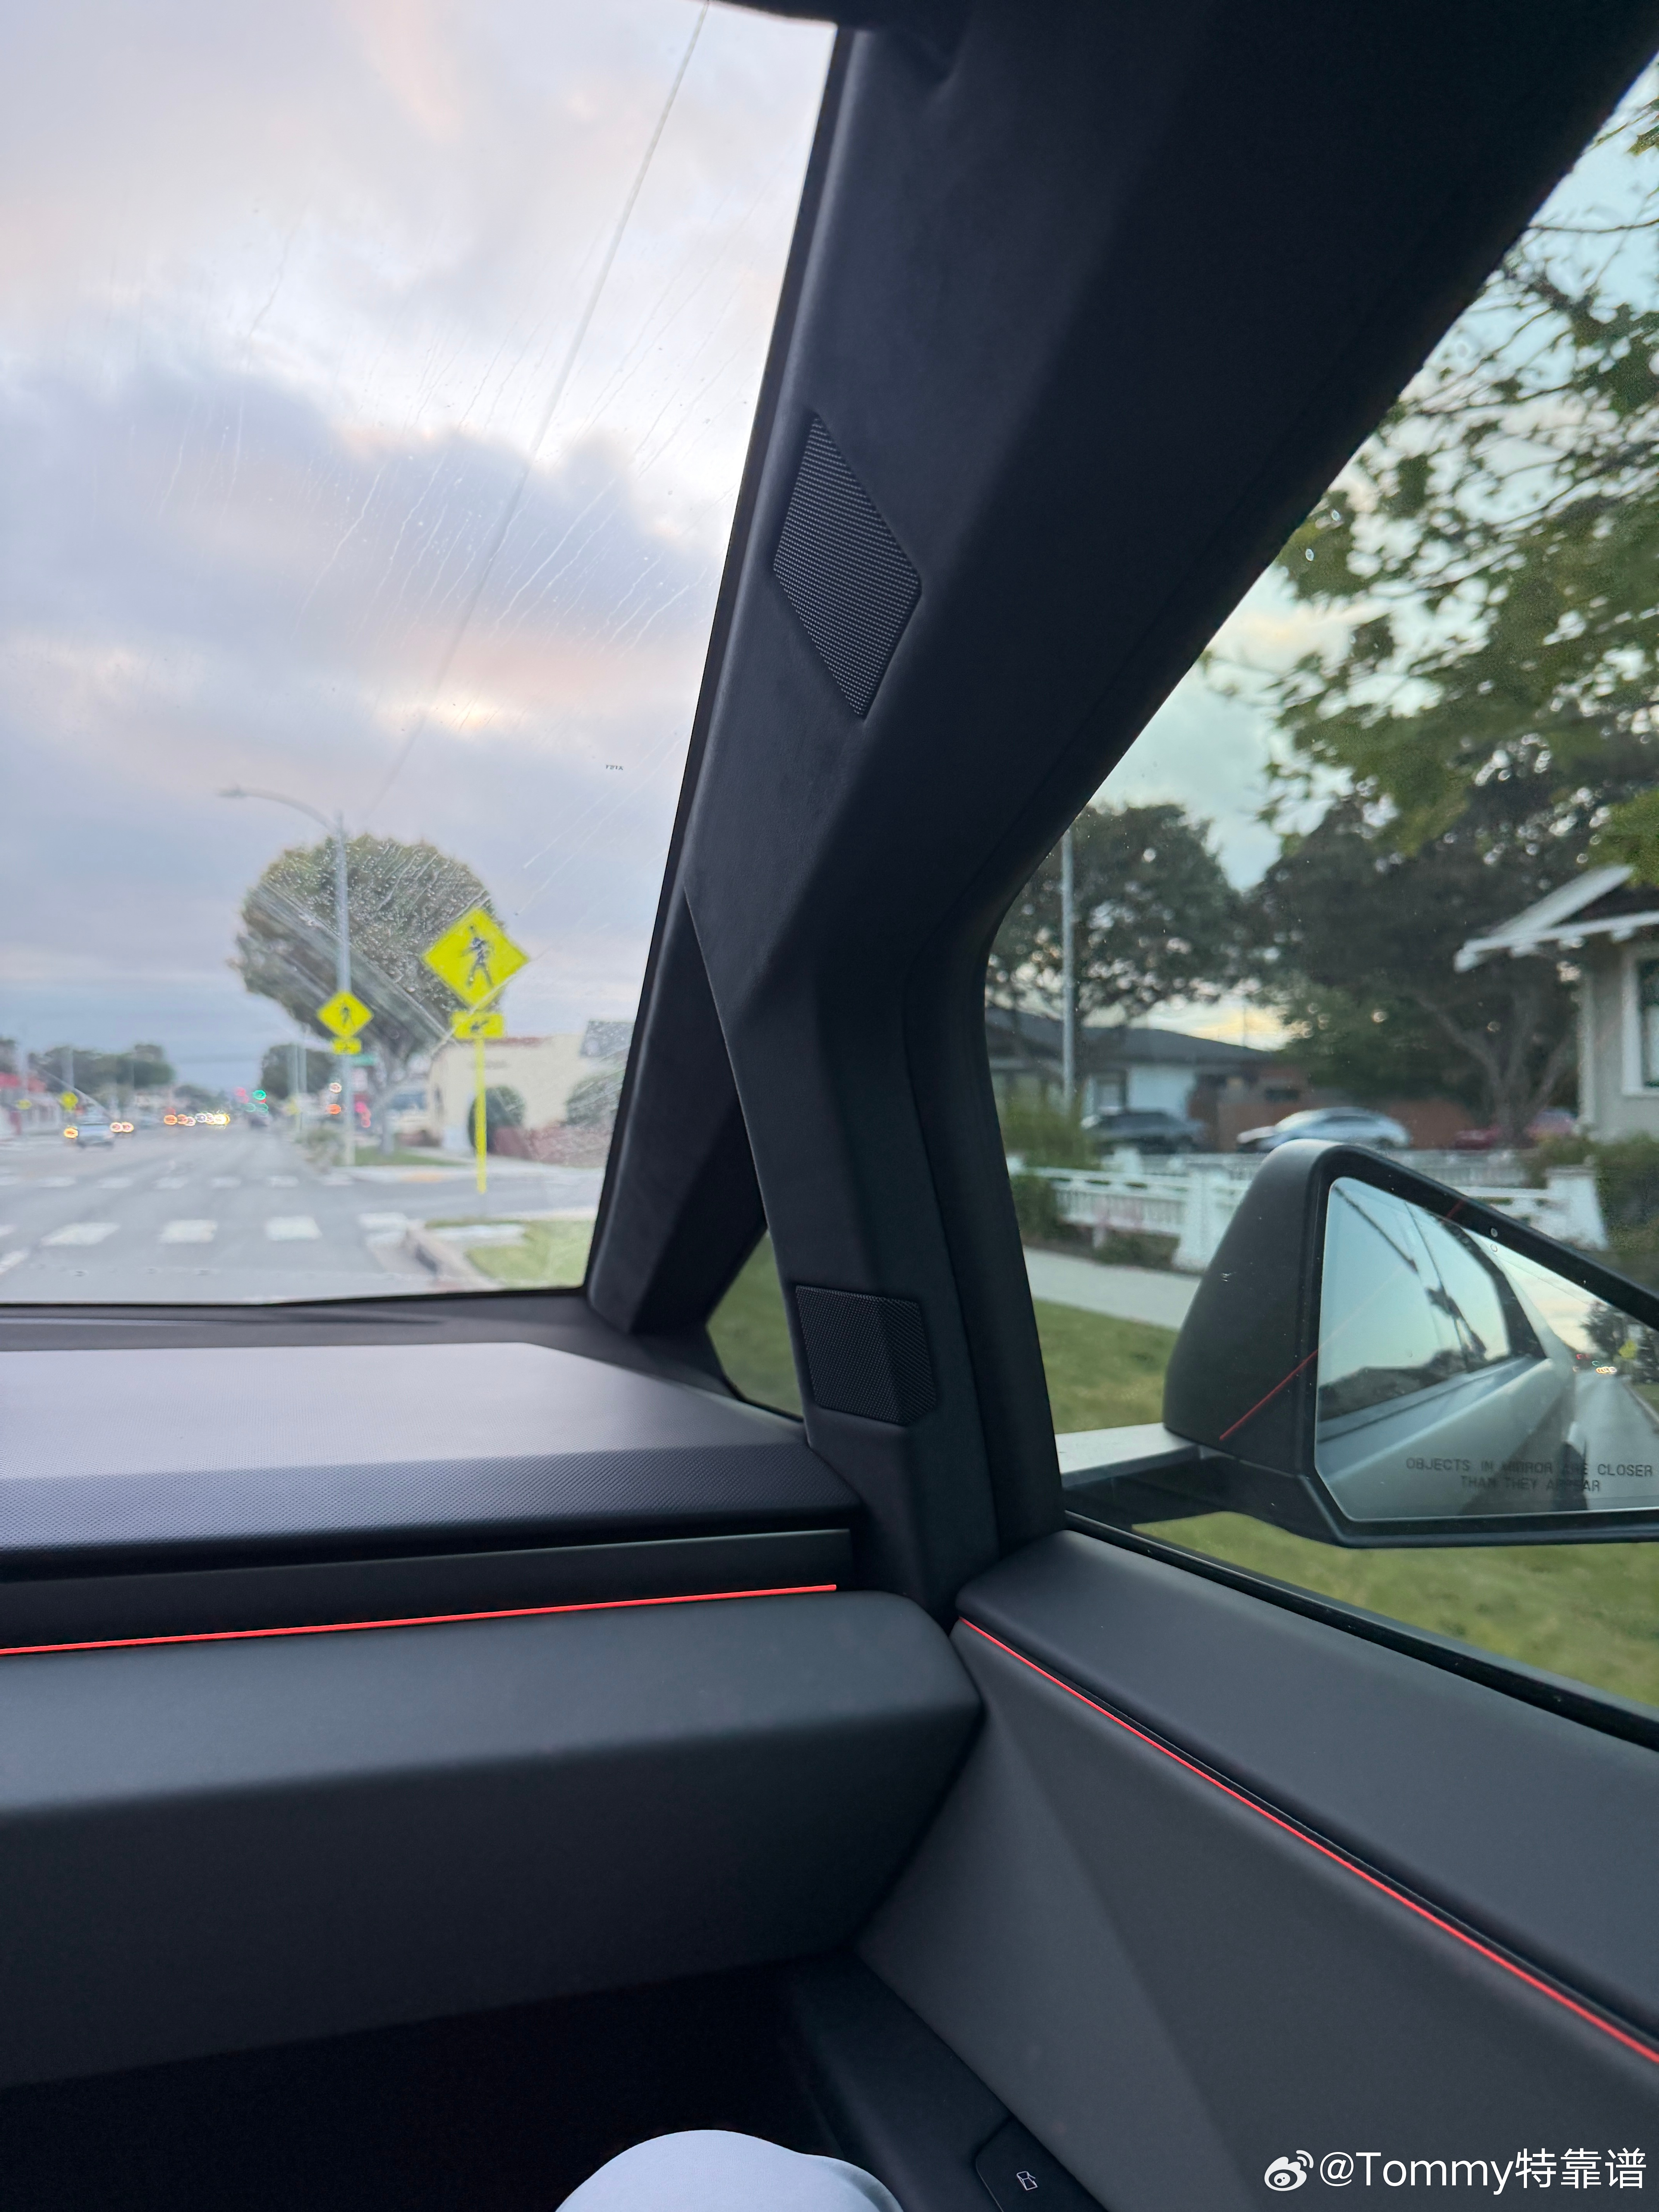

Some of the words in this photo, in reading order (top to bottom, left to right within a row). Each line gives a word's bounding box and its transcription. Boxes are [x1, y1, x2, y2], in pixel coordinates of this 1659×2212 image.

[1406, 1457, 1470, 1472] OBJECTS
[1481, 1460, 1493, 1472] IN
[1597, 1463, 1653, 1477] CLOSER
[1461, 1475, 1496, 1489] THAN
[1504, 1477, 1537, 1490] THEY
